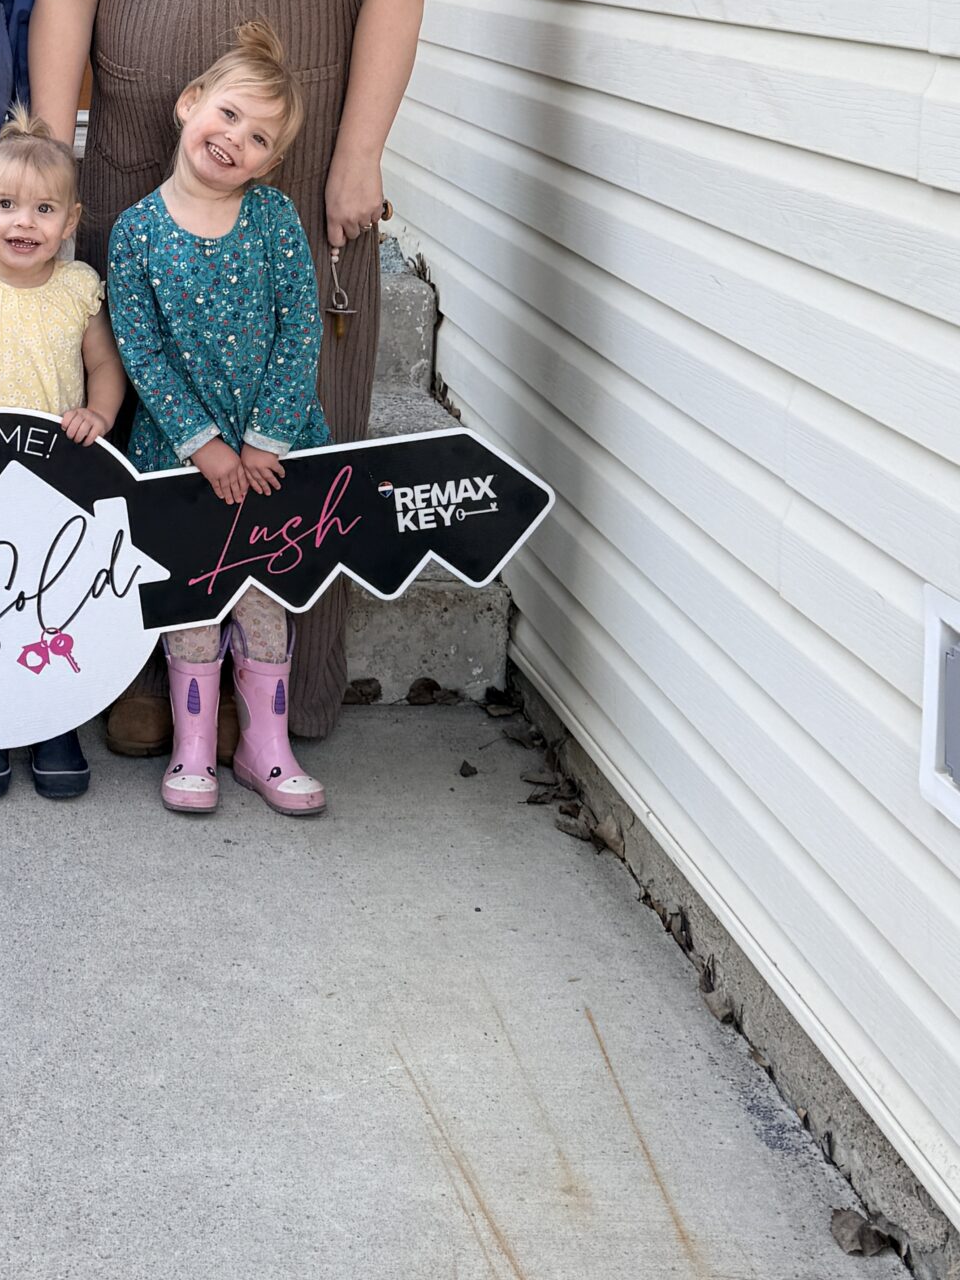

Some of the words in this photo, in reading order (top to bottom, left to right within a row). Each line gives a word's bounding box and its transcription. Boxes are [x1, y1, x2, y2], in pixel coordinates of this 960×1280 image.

[393, 474, 498, 512] REMAX
[188, 465, 362, 595] Lush
[396, 504, 457, 533] KEY
